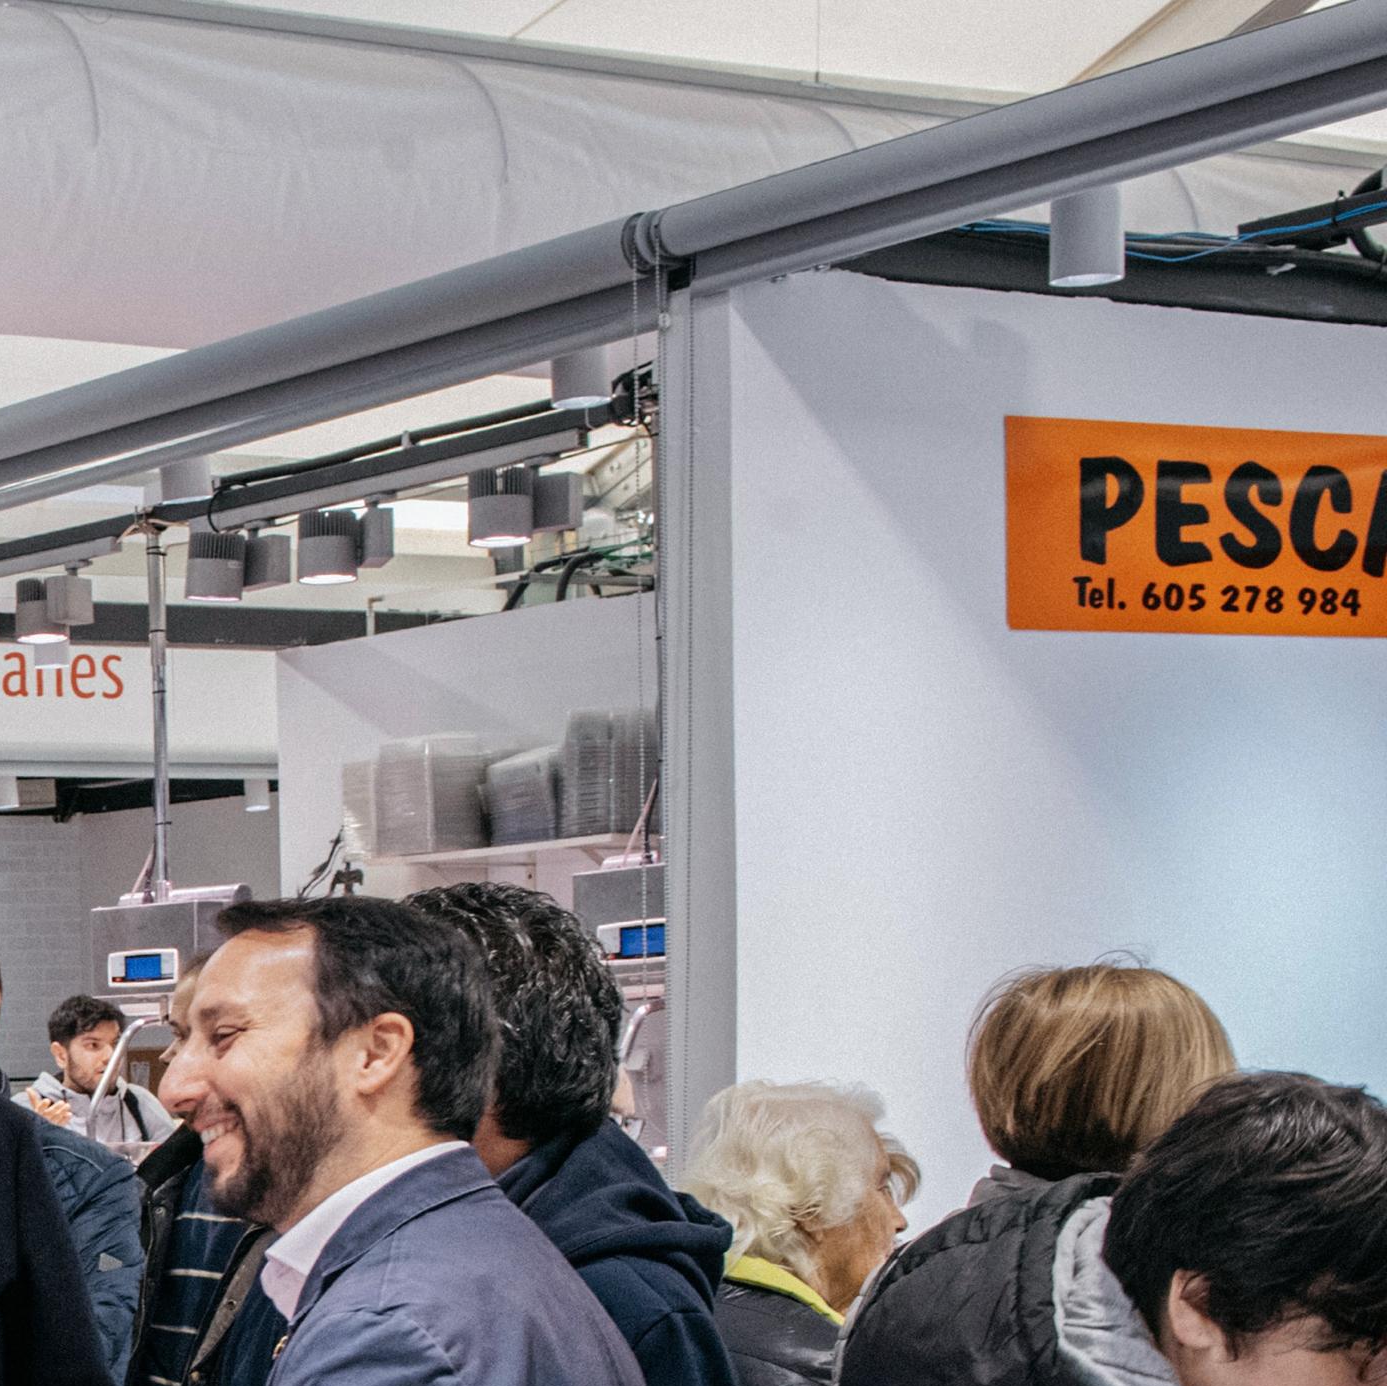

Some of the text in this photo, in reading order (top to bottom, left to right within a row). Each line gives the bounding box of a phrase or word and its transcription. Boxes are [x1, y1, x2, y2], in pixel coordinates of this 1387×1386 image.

[1073, 576, 1361, 617] Tel. 605 278 984
